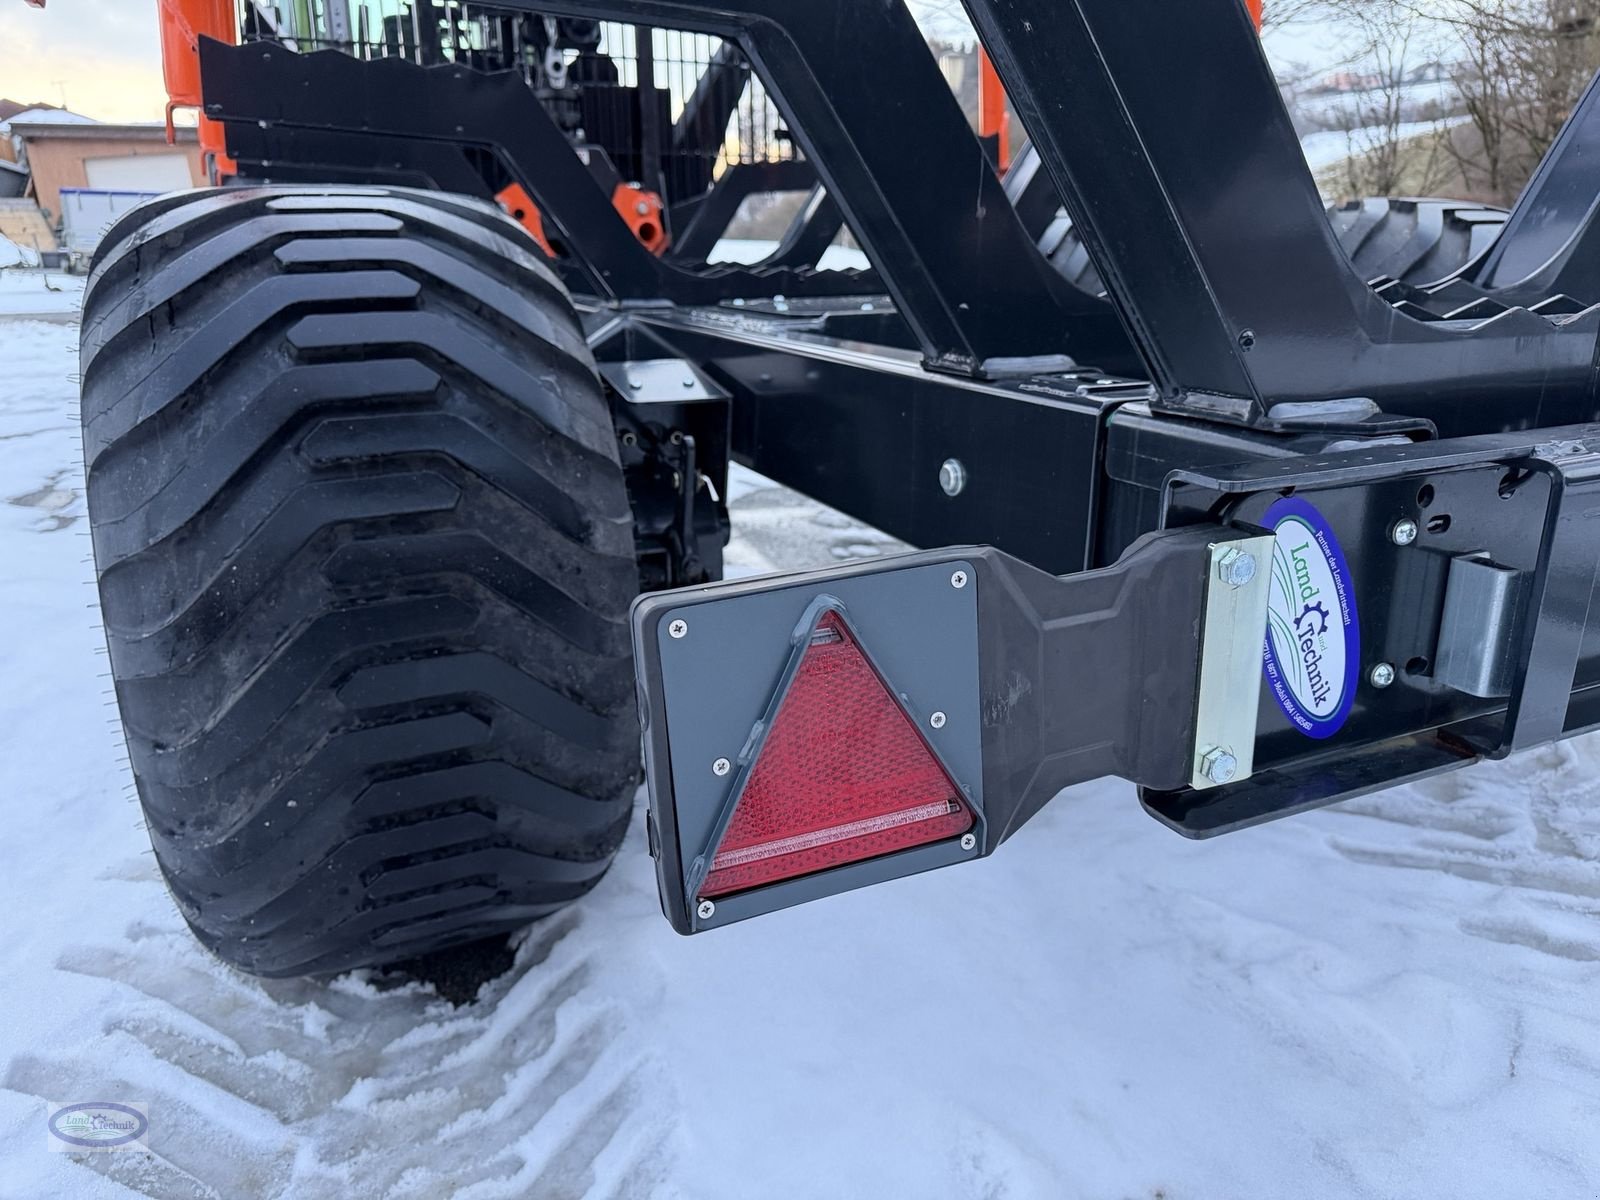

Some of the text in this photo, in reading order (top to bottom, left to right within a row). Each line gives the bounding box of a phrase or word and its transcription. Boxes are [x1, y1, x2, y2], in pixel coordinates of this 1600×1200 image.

[1290, 541, 1331, 709] Land und Technik
[1315, 530, 1351, 626] Partner der Landwirtschaft
[1274, 681, 1287, 701] Mobil
